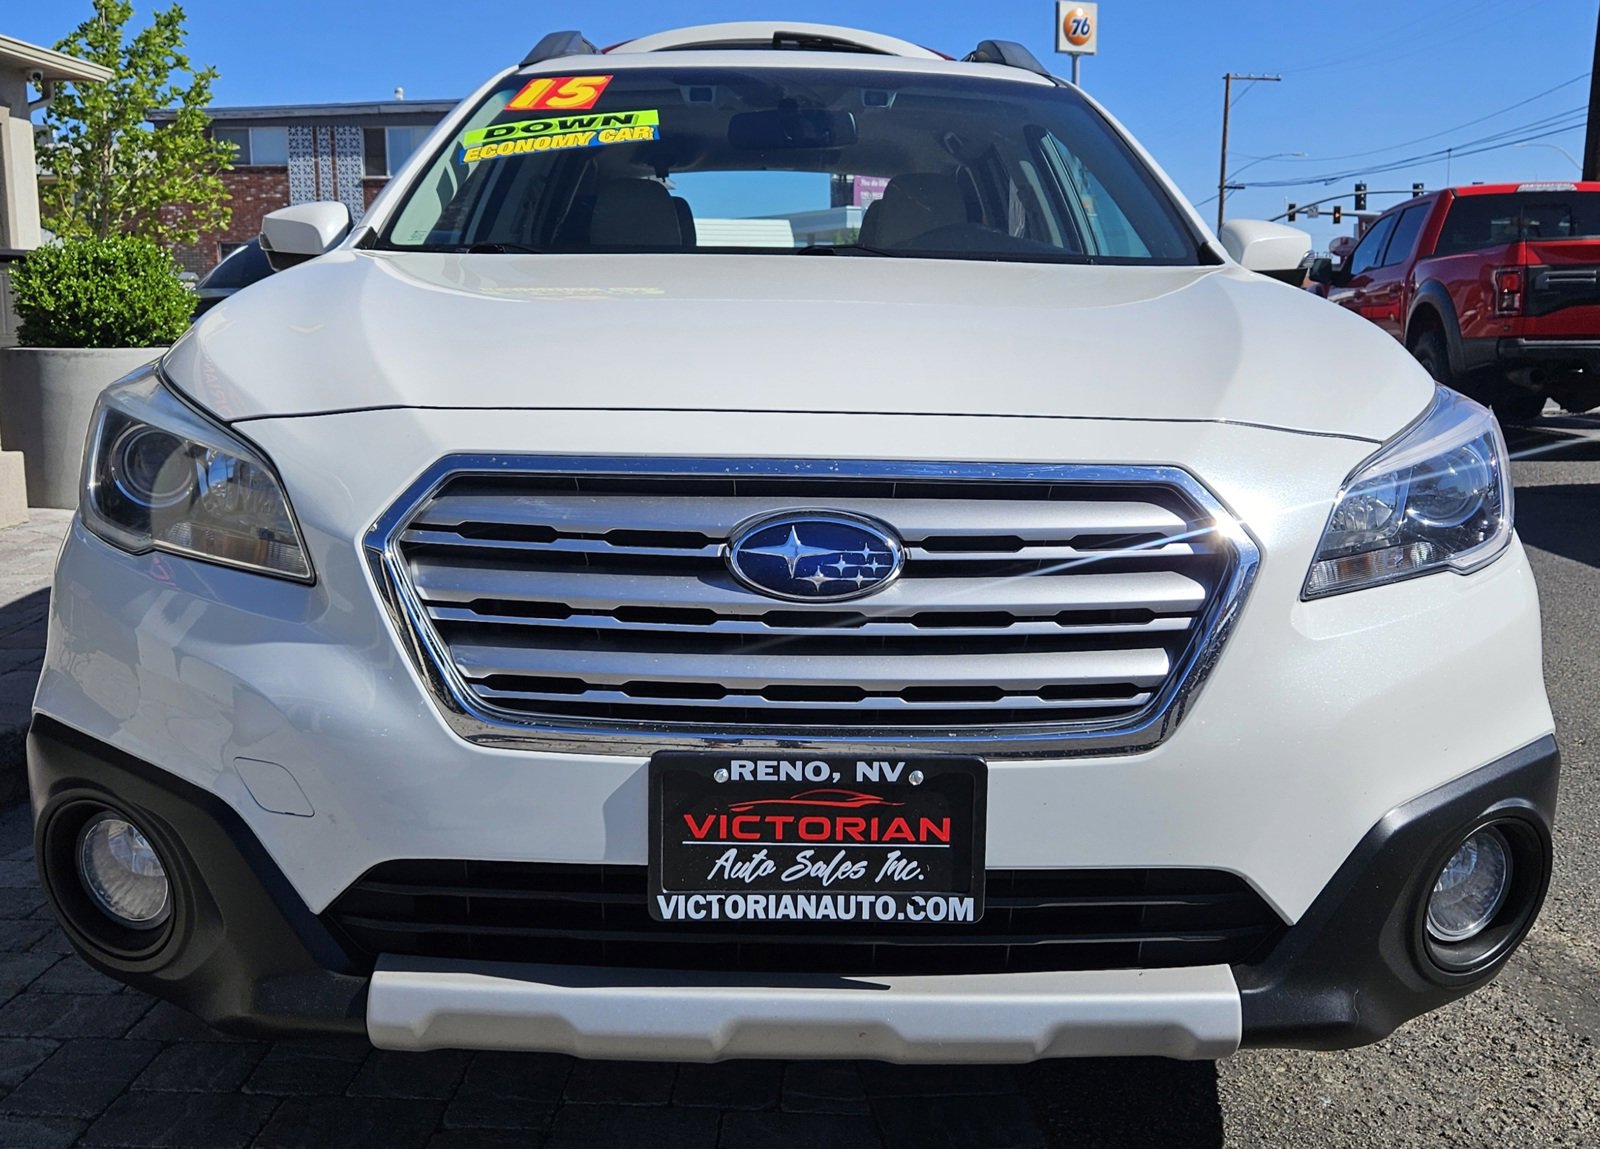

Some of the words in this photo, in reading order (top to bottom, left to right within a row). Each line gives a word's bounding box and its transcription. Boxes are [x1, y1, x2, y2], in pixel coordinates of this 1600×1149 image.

[1071, 16, 1091, 36] 76
[509, 76, 607, 108] 15
[482, 112, 638, 140] DOWN
[463, 131, 595, 163] ECONOMY
[597, 126, 655, 143] CAR
[730, 760, 841, 784] RENO,
[856, 761, 905, 782] NV
[683, 814, 951, 842] VICTORIAN
[707, 848, 776, 883] Auto
[781, 849, 868, 887] Sales
[875, 850, 924, 883] Inc.
[656, 894, 975, 922] VICTORIANAUTO.COM
